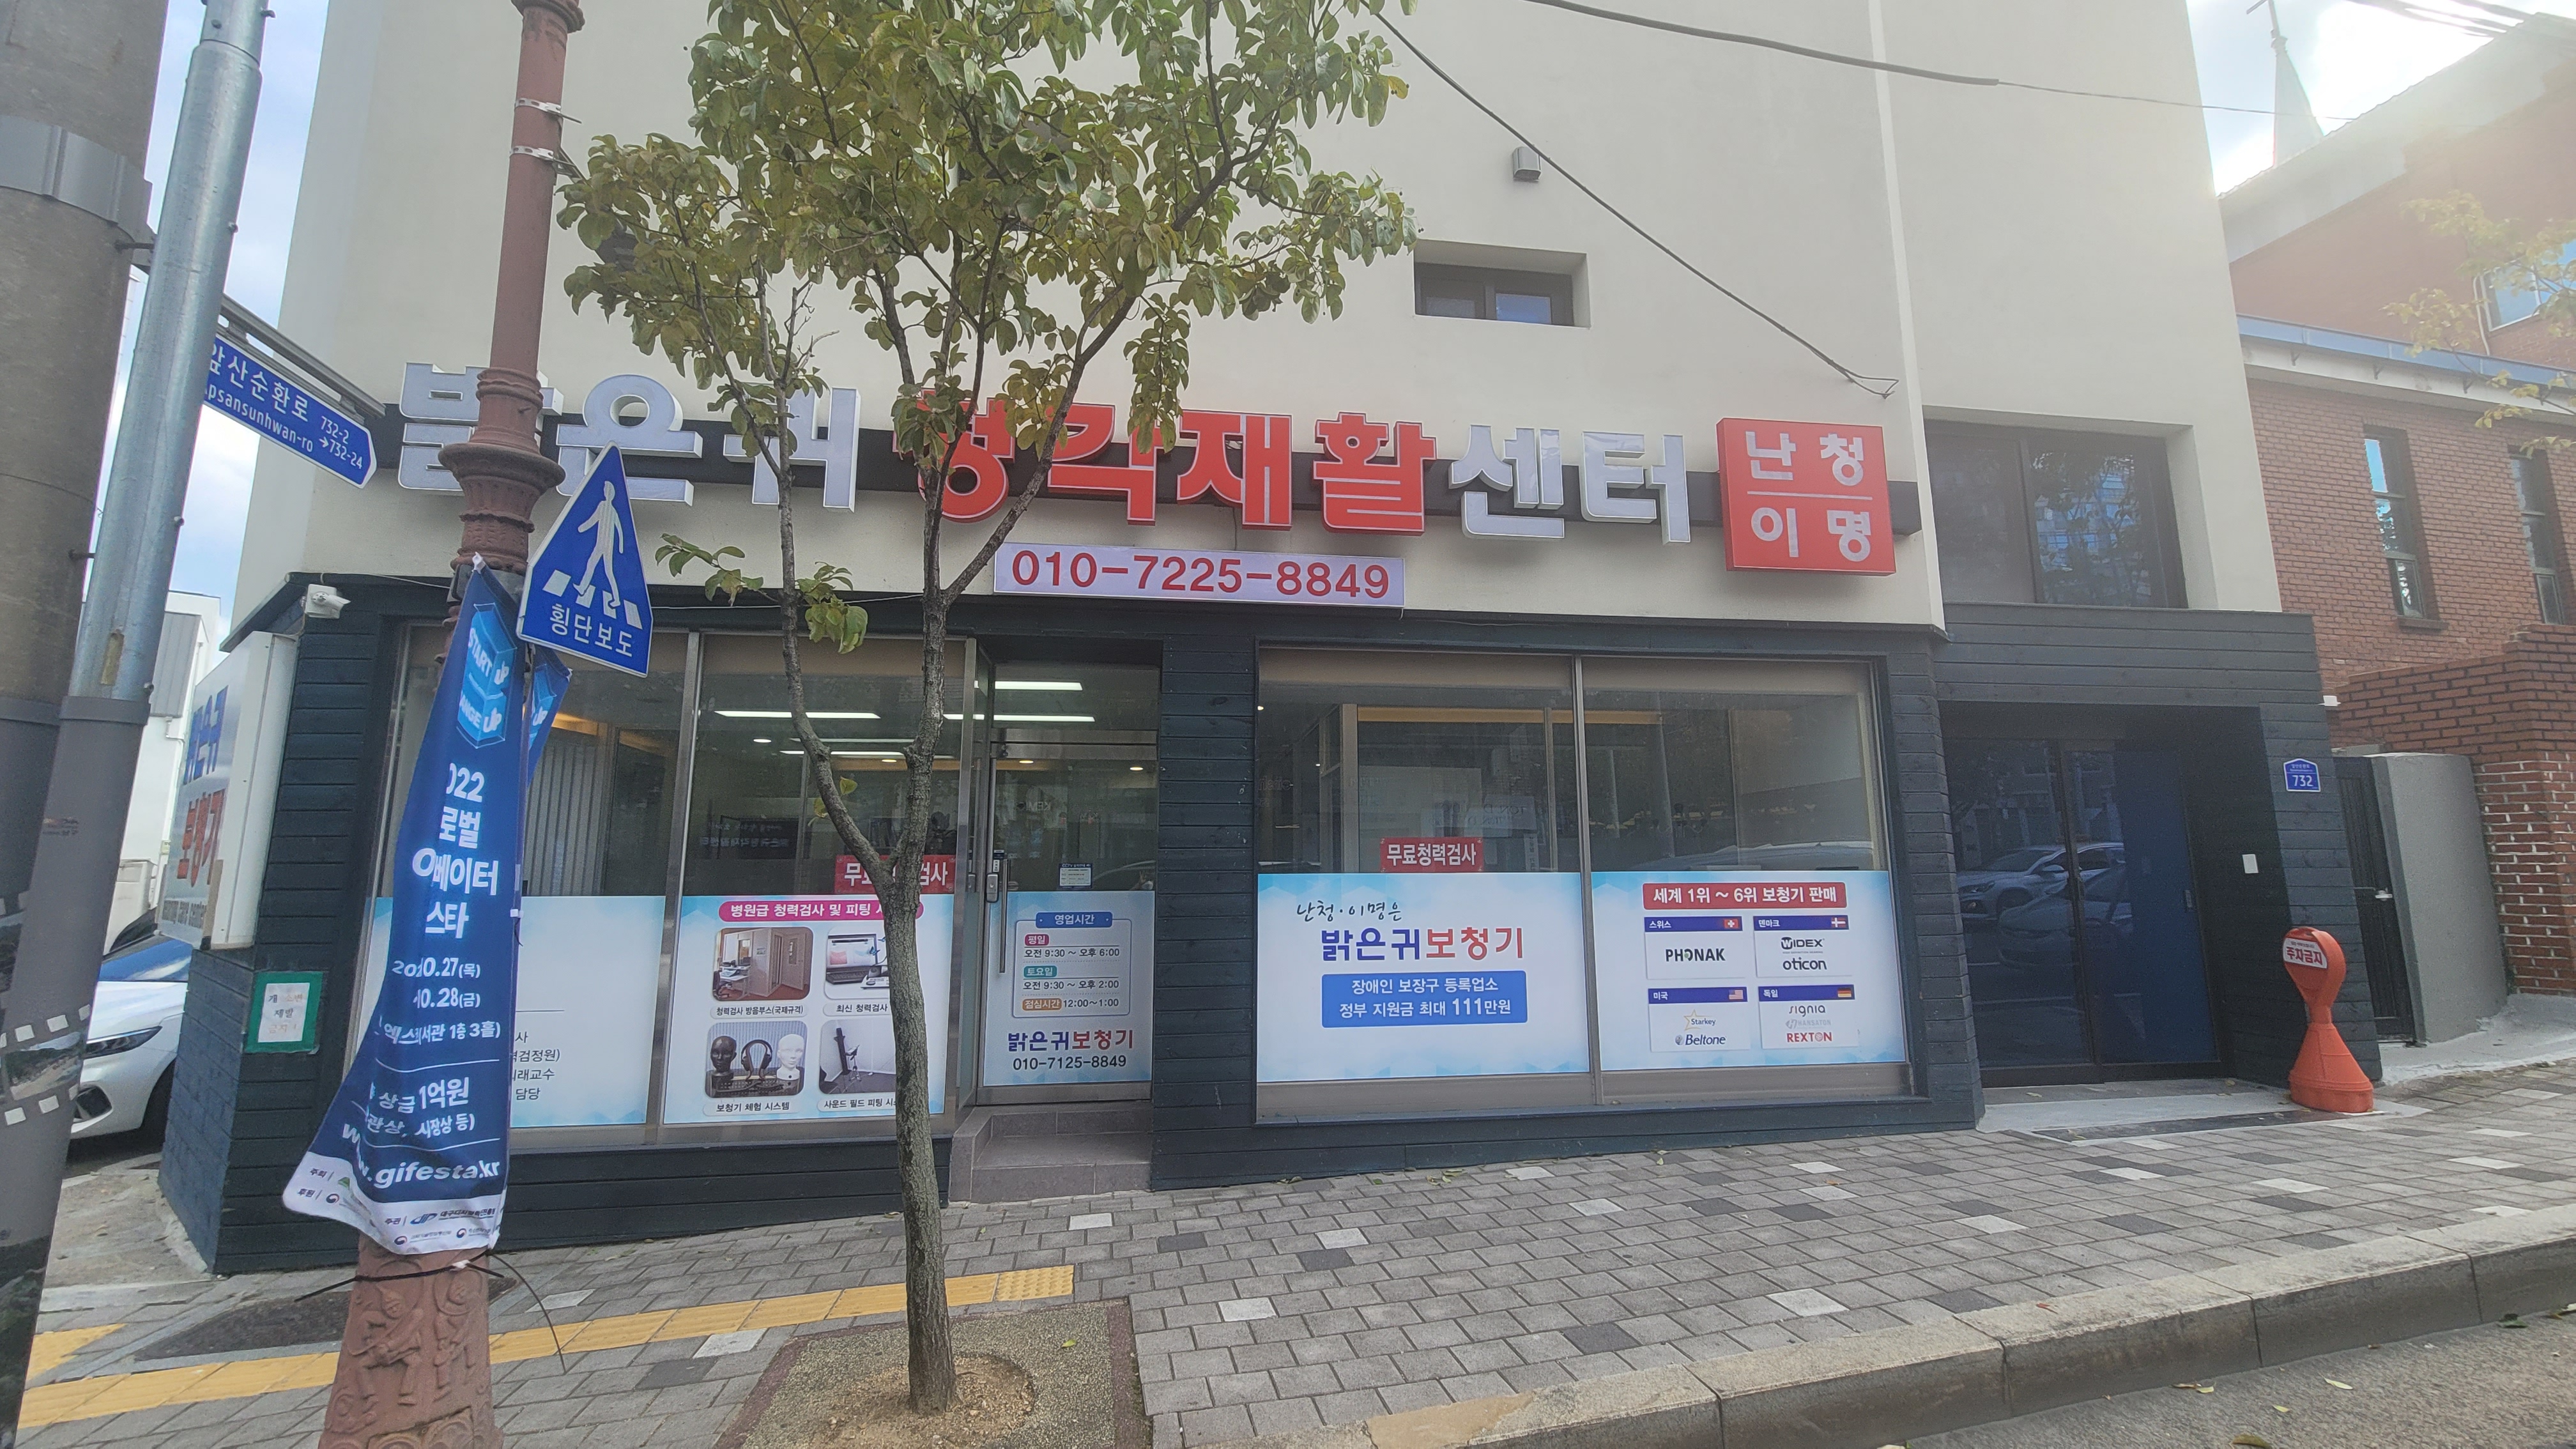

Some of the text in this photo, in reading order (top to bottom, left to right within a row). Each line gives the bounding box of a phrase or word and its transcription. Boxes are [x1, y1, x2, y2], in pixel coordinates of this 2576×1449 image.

[204, 383, 314, 453] psansunhwan-ro
[321, 415, 350, 445] 732-2
[329, 438, 364, 470] 732-24
[1745, 431, 1864, 487] 난청
[1751, 507, 1872, 562] 이명
[1011, 549, 1390, 599] 010-7225-8849
[549, 602, 633, 658] 횡단보도
[2292, 774, 2314, 787] 732
[438, 806, 481, 849] 로벌
[1386, 842, 1477, 866] 무료청력검사
[1653, 887, 1682, 903] 세계
[1687, 887, 1710, 903] 1위
[1734, 887, 1758, 903] 6위
[1762, 887, 1804, 903] 보청기
[1809, 886, 1837, 903] 판매
[730, 903, 769, 917] 병원급
[773, 903, 825, 917] 청력검사
[829, 903, 841, 917] 및
[845, 903, 871, 916] 피팅
[424, 901, 470, 939] 스타
[1054, 914, 1095, 925] 영업시간
[1648, 919, 1672, 929] 스위스
[1758, 919, 1781, 928] 덴마크
[1027, 935, 1046, 945] 평일
[1321, 926, 1524, 962] 밝은귀보청기
[1781, 937, 1823, 950] WIDEX
[1023, 949, 1042, 958] 오전
[1045, 949, 1065, 957] 9:30
[1078, 948, 1096, 957] 오후
[1099, 948, 1120, 956] 6:00
[1665, 947, 1726, 962] PHONAK
[2286, 946, 2323, 965] 주차금지
[1782, 956, 1828, 970] oticon
[1027, 967, 1054, 977] 토요일
[1023, 981, 1041, 990] 오전
[1043, 981, 1064, 990] 9:30
[1078, 980, 1096, 990] 오후
[1098, 980, 1119, 988] 2:00
[1351, 977, 1499, 995] 장애인 보장구 등록업소
[1653, 992, 1669, 1000] 미국
[1763, 989, 1779, 998] 독일
[716, 1005, 804, 1016] 청력검사 방음부스(국제규격)
[836, 1004, 888, 1013] 최신 청력검사
[1025, 999, 1061, 1009] 점심시간
[1339, 998, 1512, 1018] 정부 지원금 최대 111만원
[1788, 1004, 1826, 1017] signia
[1690, 1017, 1717, 1027] Starkey
[1008, 1029, 1134, 1052] 밝은귀보청기
[1685, 1034, 1726, 1046] Beltone
[1786, 1031, 1833, 1043] REXTON
[1012, 1054, 1127, 1071] 010-7125-8849
[512, 1068, 555, 1081] 래교수
[419, 1077, 470, 1110] 1억원
[516, 1087, 541, 1101] 담당
[716, 1101, 790, 1113] 보청기 체험 시스템
[824, 1100, 847, 1109] 사운드
[850, 1099, 865, 1108] 필드
[867, 1098, 882, 1107] 피팅
[456, 1113, 475, 1131] 등)
